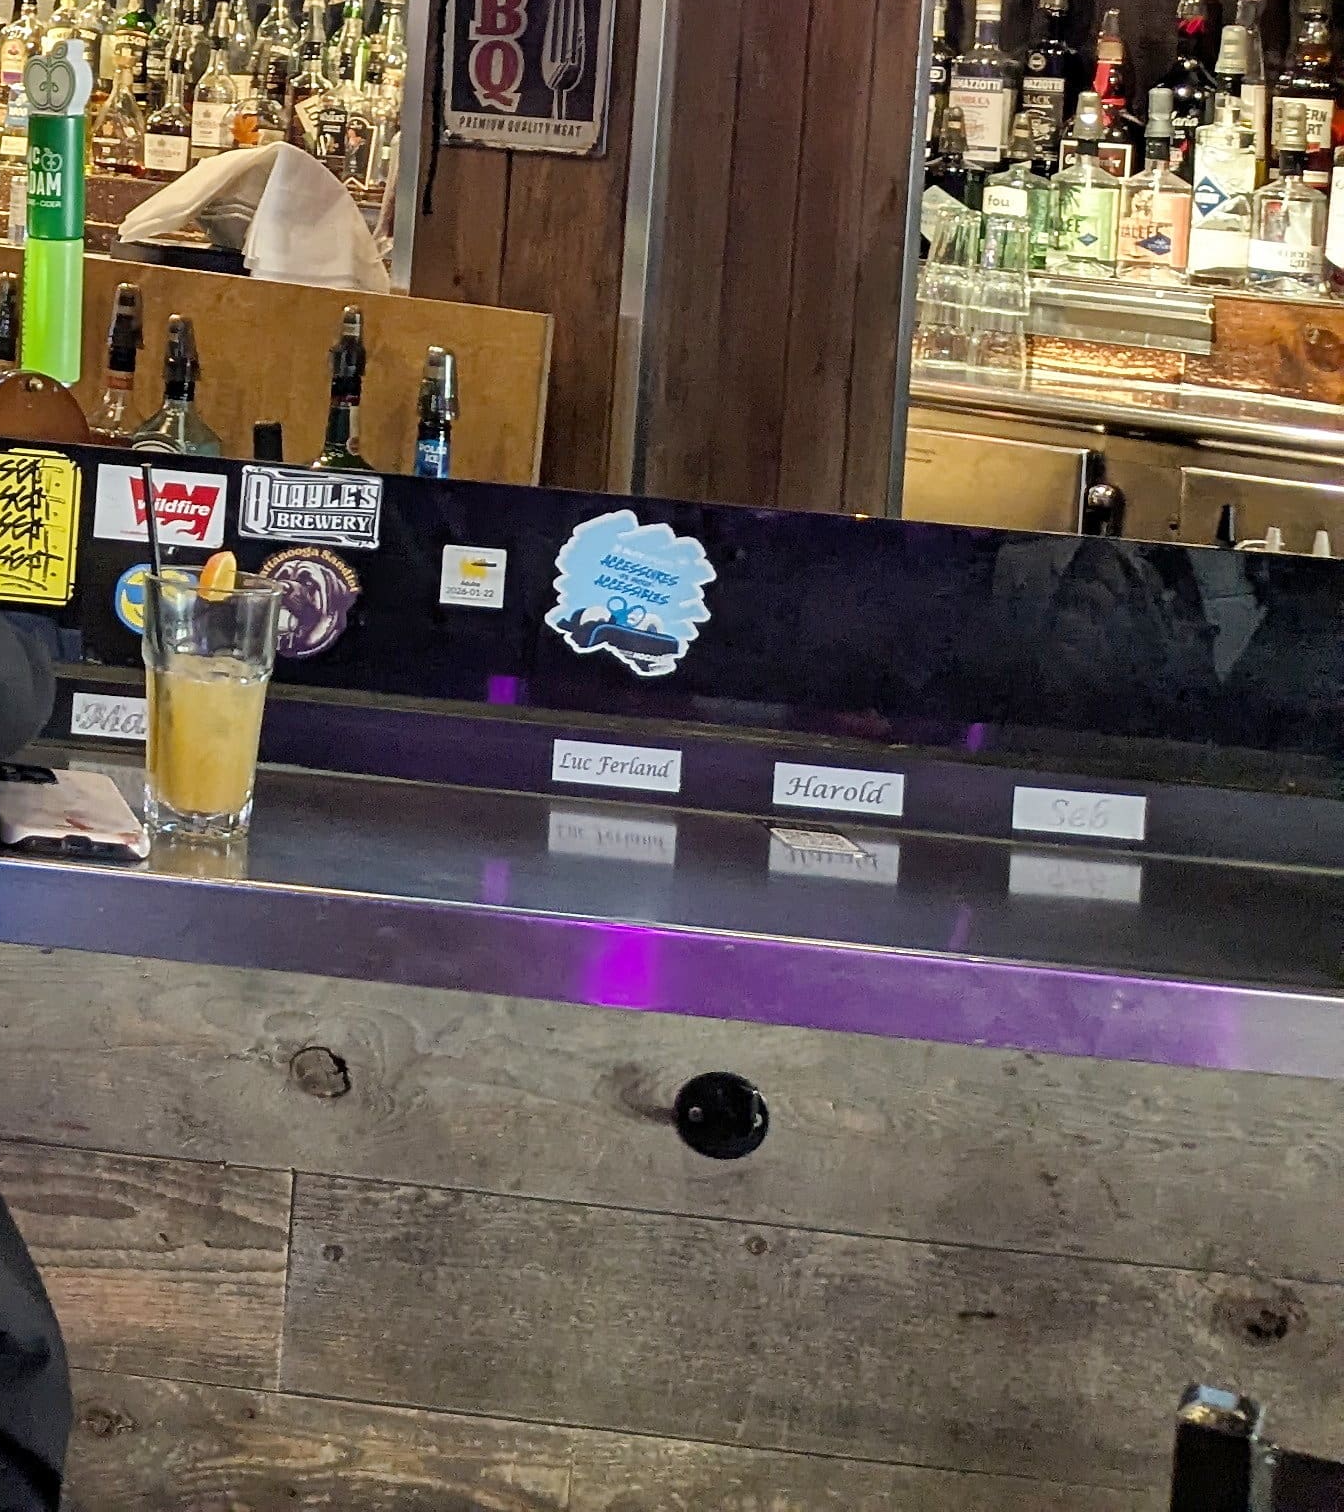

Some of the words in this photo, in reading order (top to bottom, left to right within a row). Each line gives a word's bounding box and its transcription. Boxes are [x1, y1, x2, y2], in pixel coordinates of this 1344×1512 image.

[459, 114, 505, 132] PREMIUM
[507, 117, 552, 135] QUALITY
[553, 120, 583, 138] MEAT
[28, 170, 62, 197] DAM
[276, 513, 370, 532] BREWERY
[558, 752, 595, 773] Luc
[596, 754, 673, 781] Ferland
[785, 776, 889, 805] Harold
[1052, 799, 1110, 829] Seb
